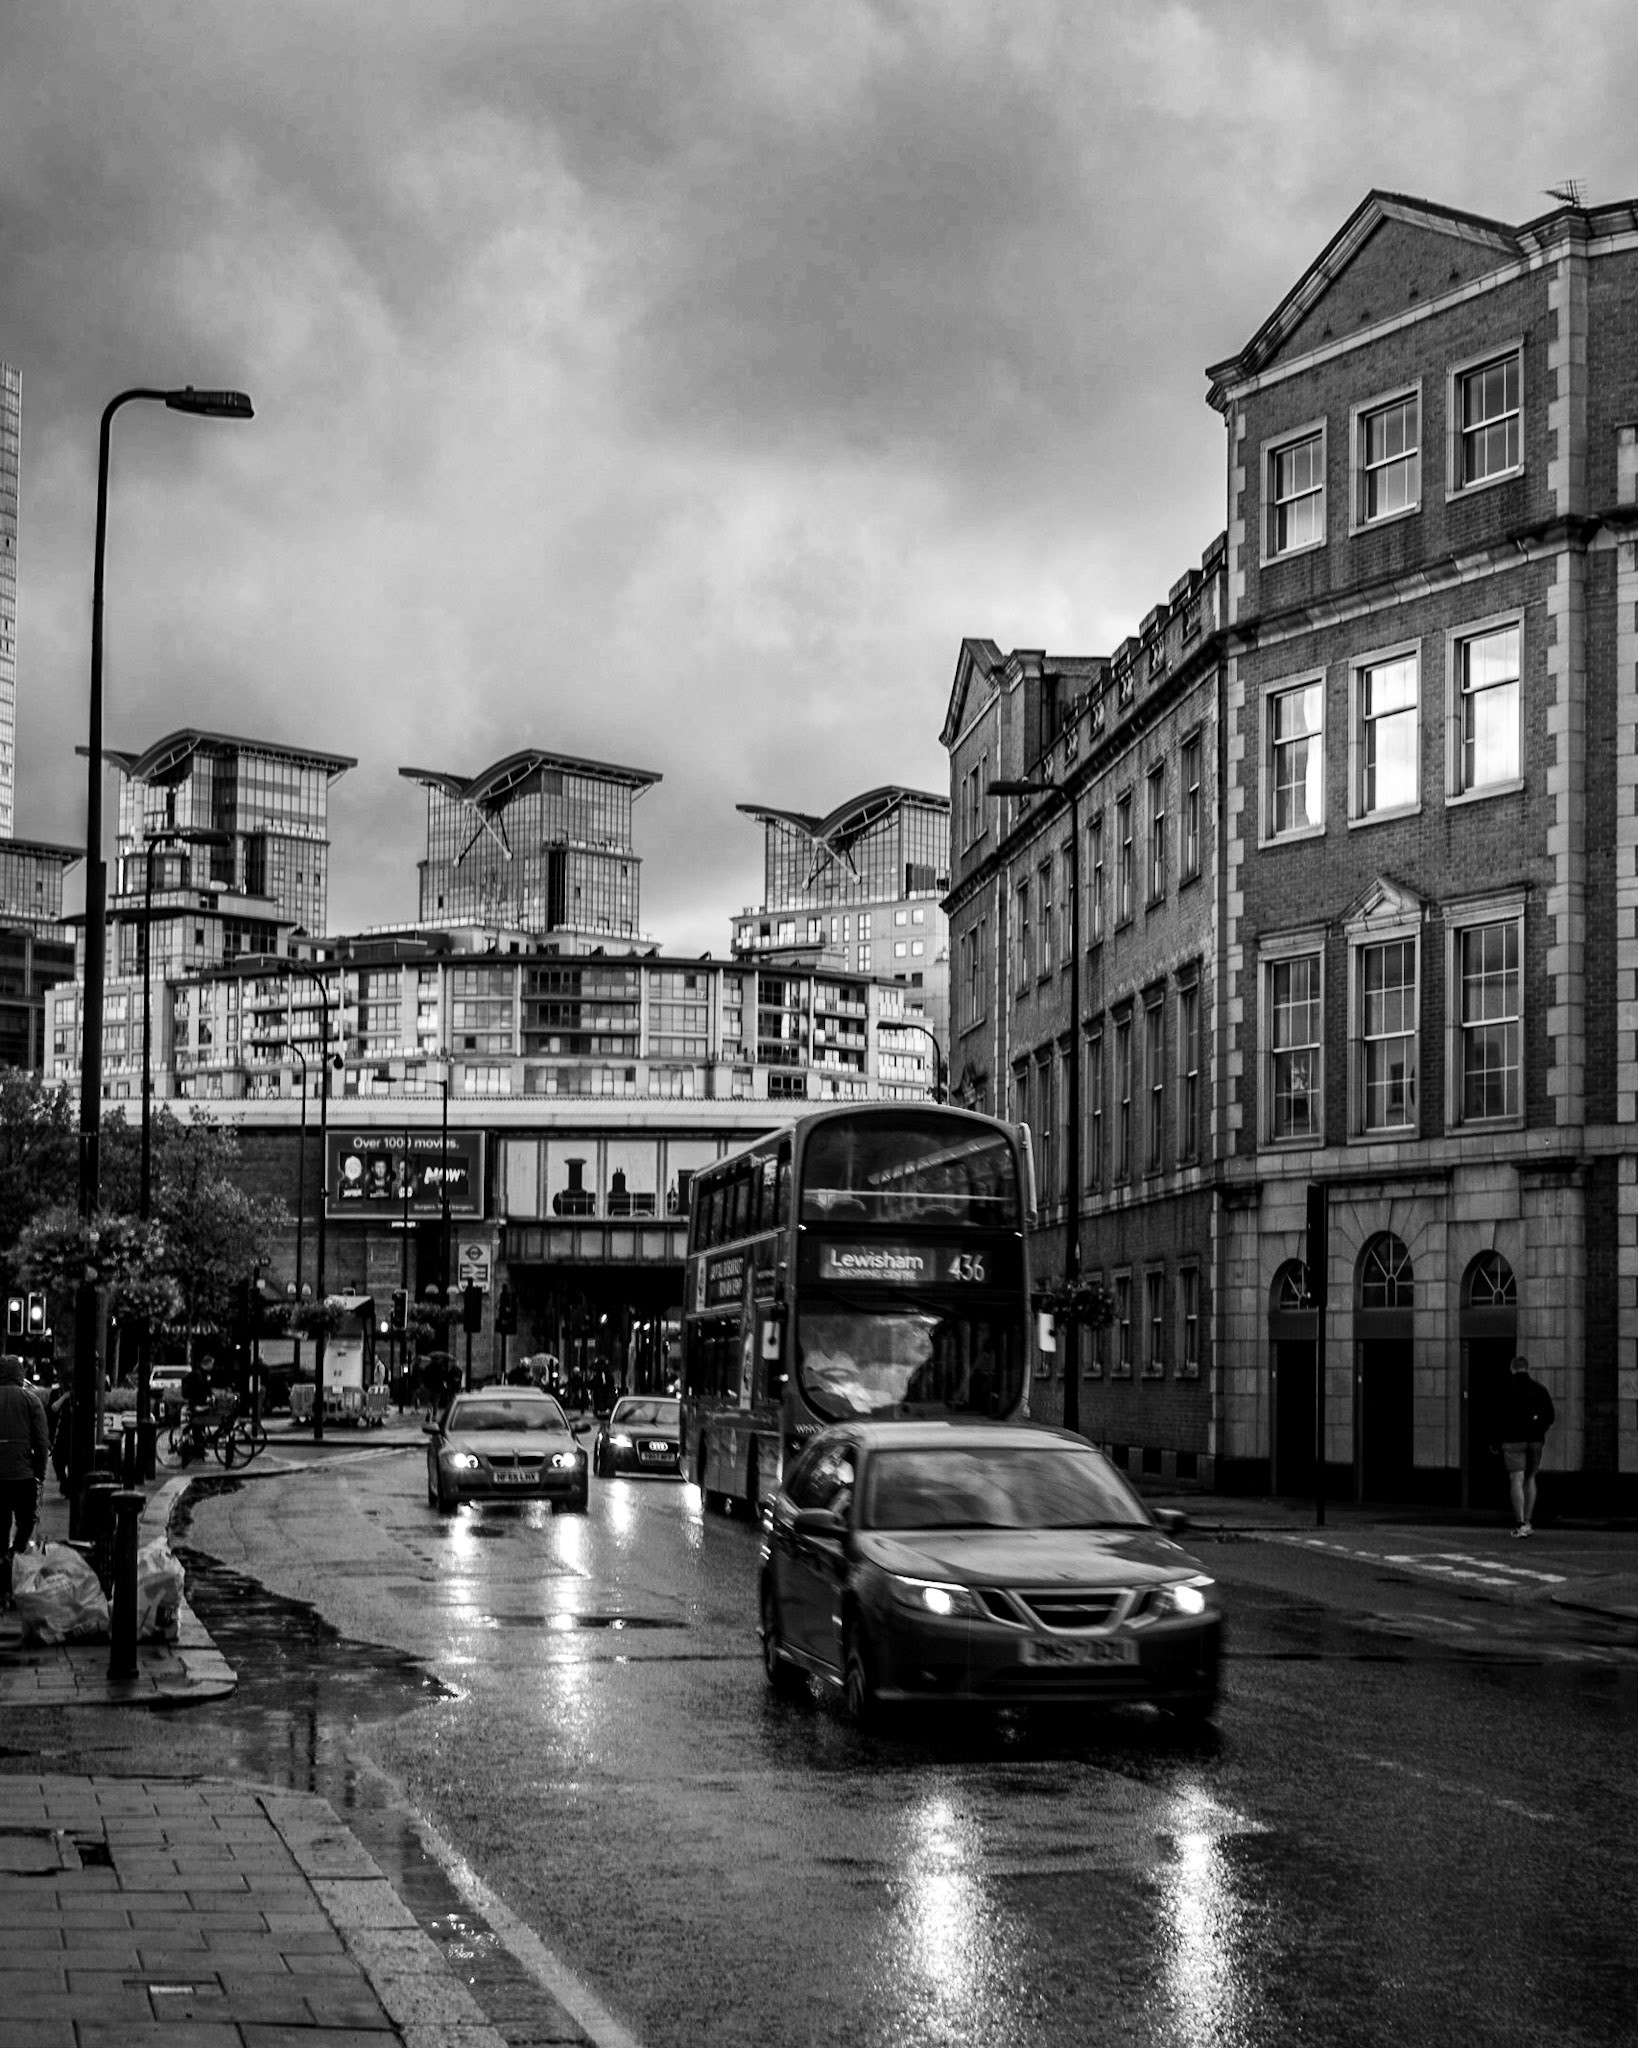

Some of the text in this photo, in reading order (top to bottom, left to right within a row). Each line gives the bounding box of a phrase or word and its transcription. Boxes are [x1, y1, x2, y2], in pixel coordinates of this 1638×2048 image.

[353, 1136, 381, 1149] Over
[384, 1136, 412, 1149] 1000
[831, 1248, 924, 1270] Lewisham
[949, 1254, 986, 1282] 436
